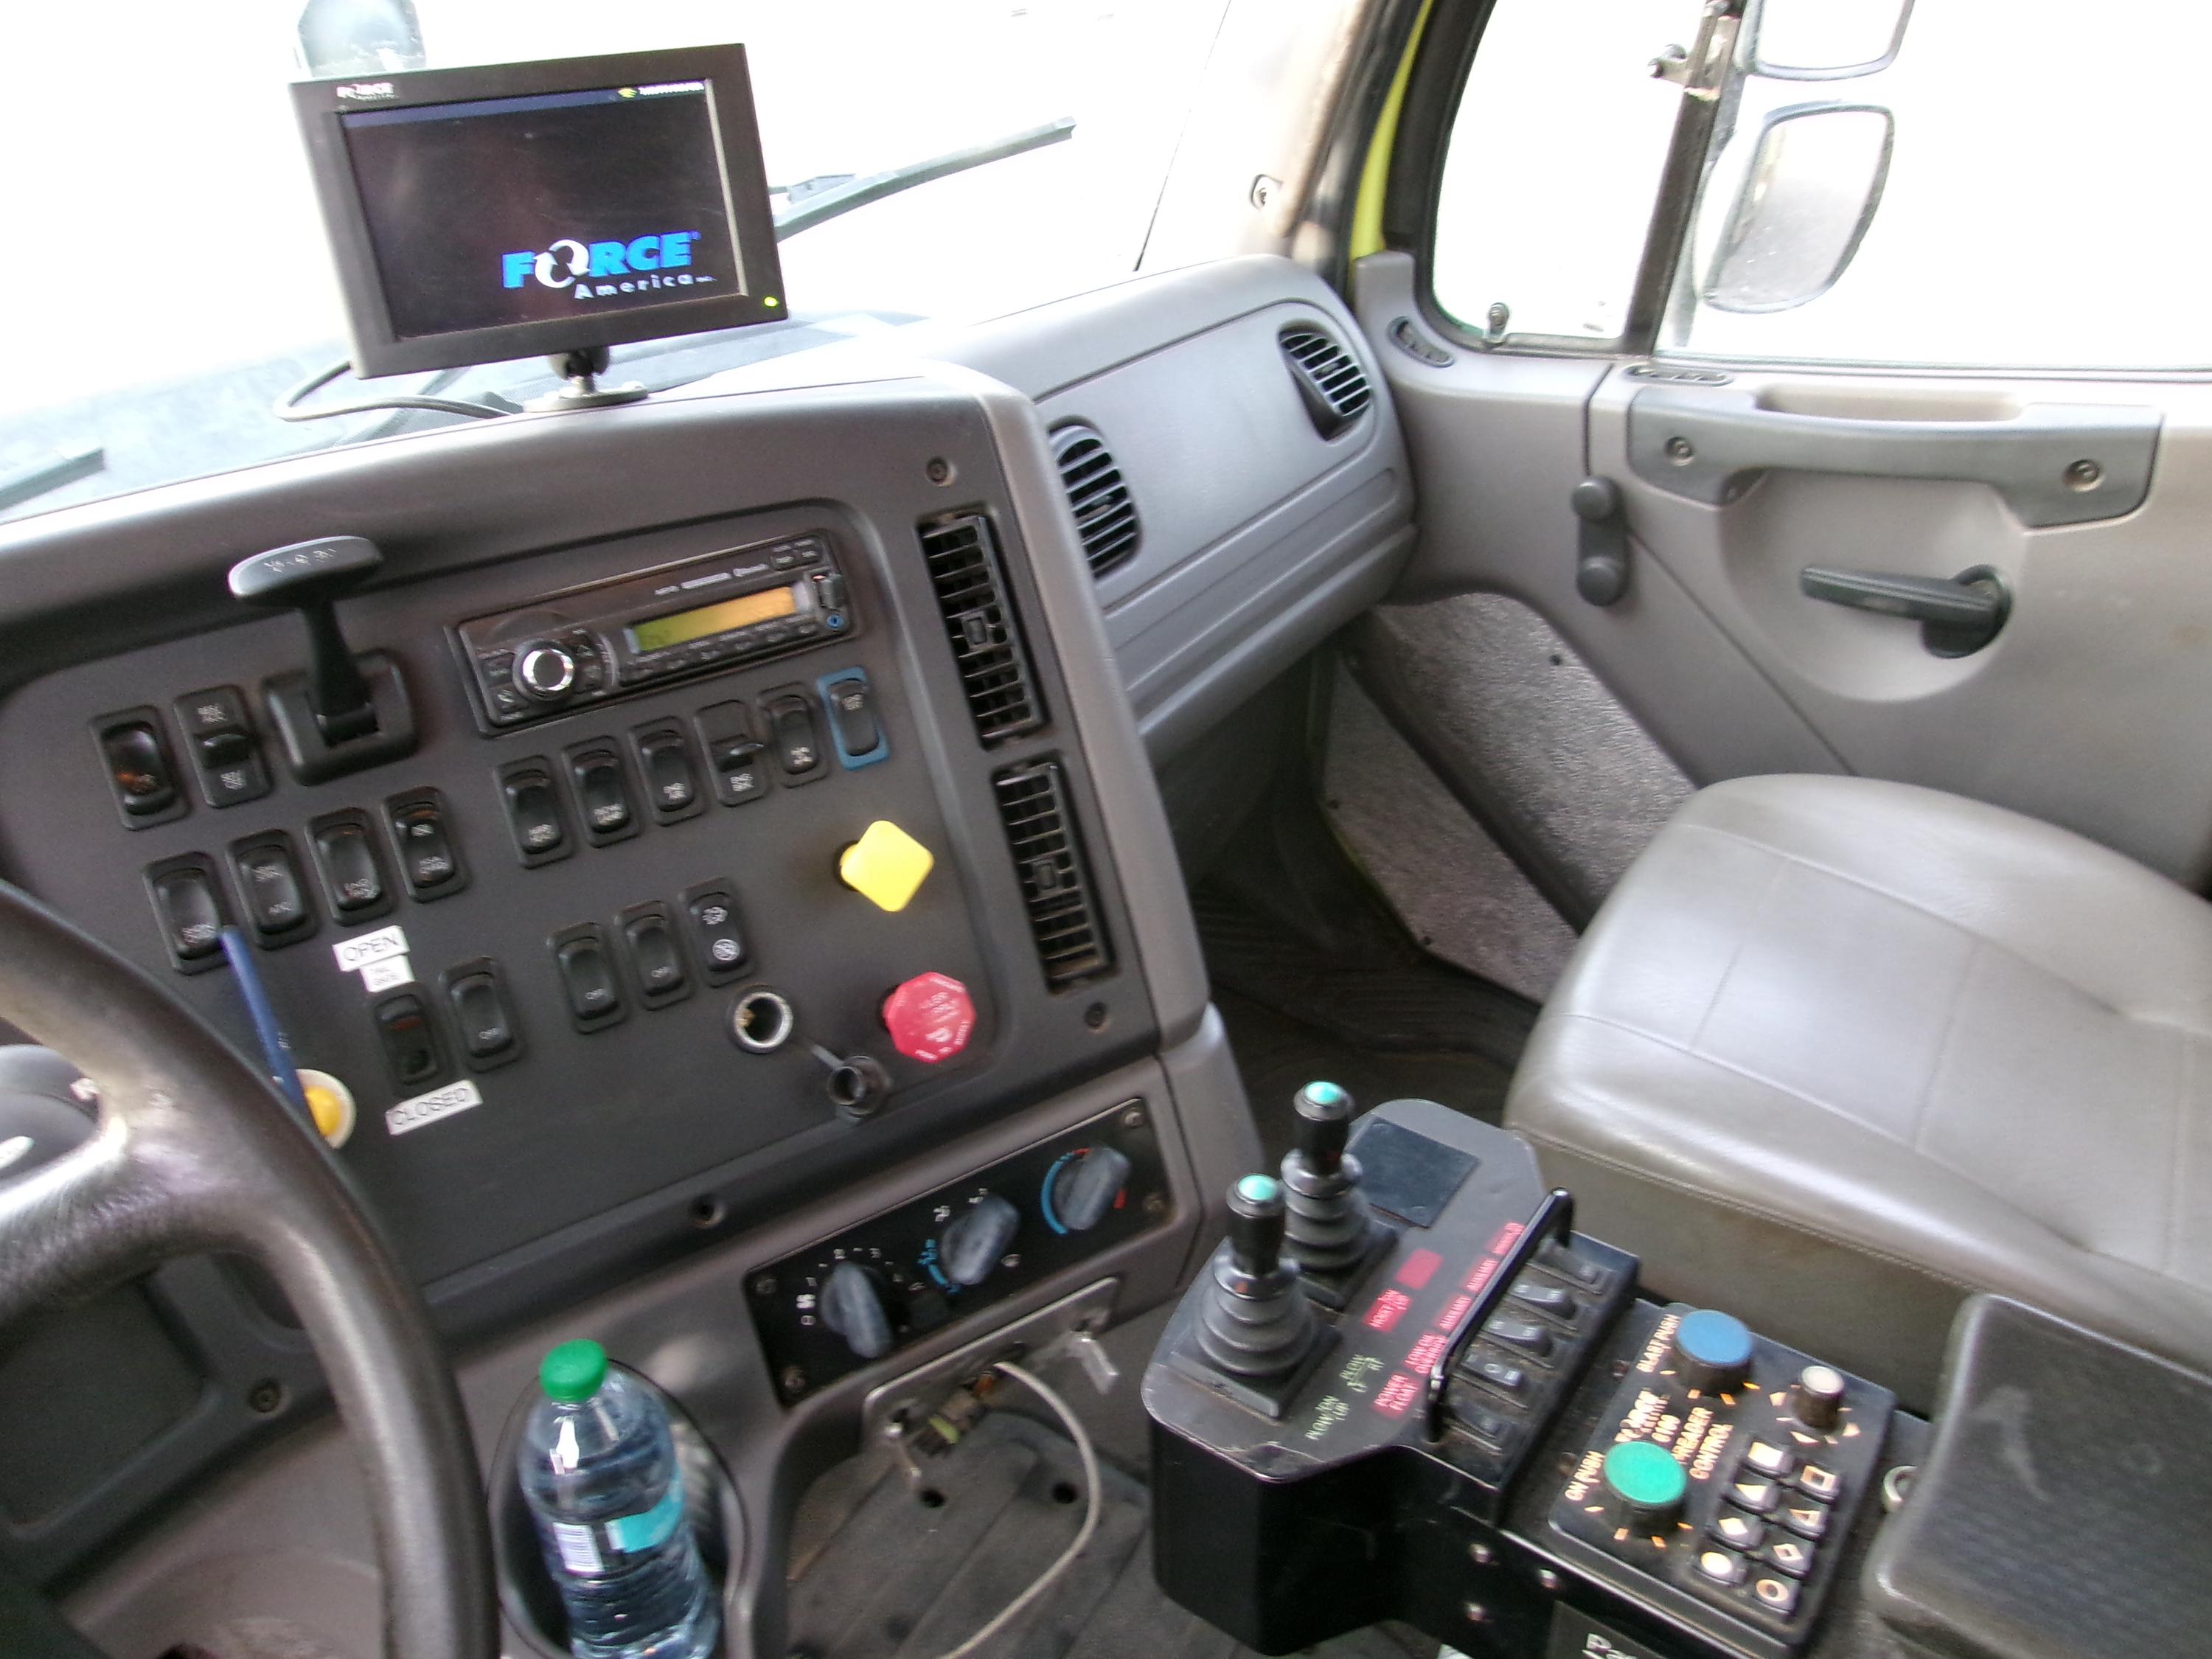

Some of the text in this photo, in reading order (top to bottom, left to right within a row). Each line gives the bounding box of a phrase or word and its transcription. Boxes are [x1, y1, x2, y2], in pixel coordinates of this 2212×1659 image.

[502, 232, 692, 289] FORCE
[574, 274, 694, 299] America
[343, 933, 400, 961] OPEN
[389, 1088, 468, 1125] CLOSED
[1636, 1314, 1681, 1373] BLAST PUSH
[1671, 1407, 1714, 1465] PREADER
[1689, 1423, 1734, 1480] CONTROL
[1565, 1450, 1605, 1500] ON PUSH
